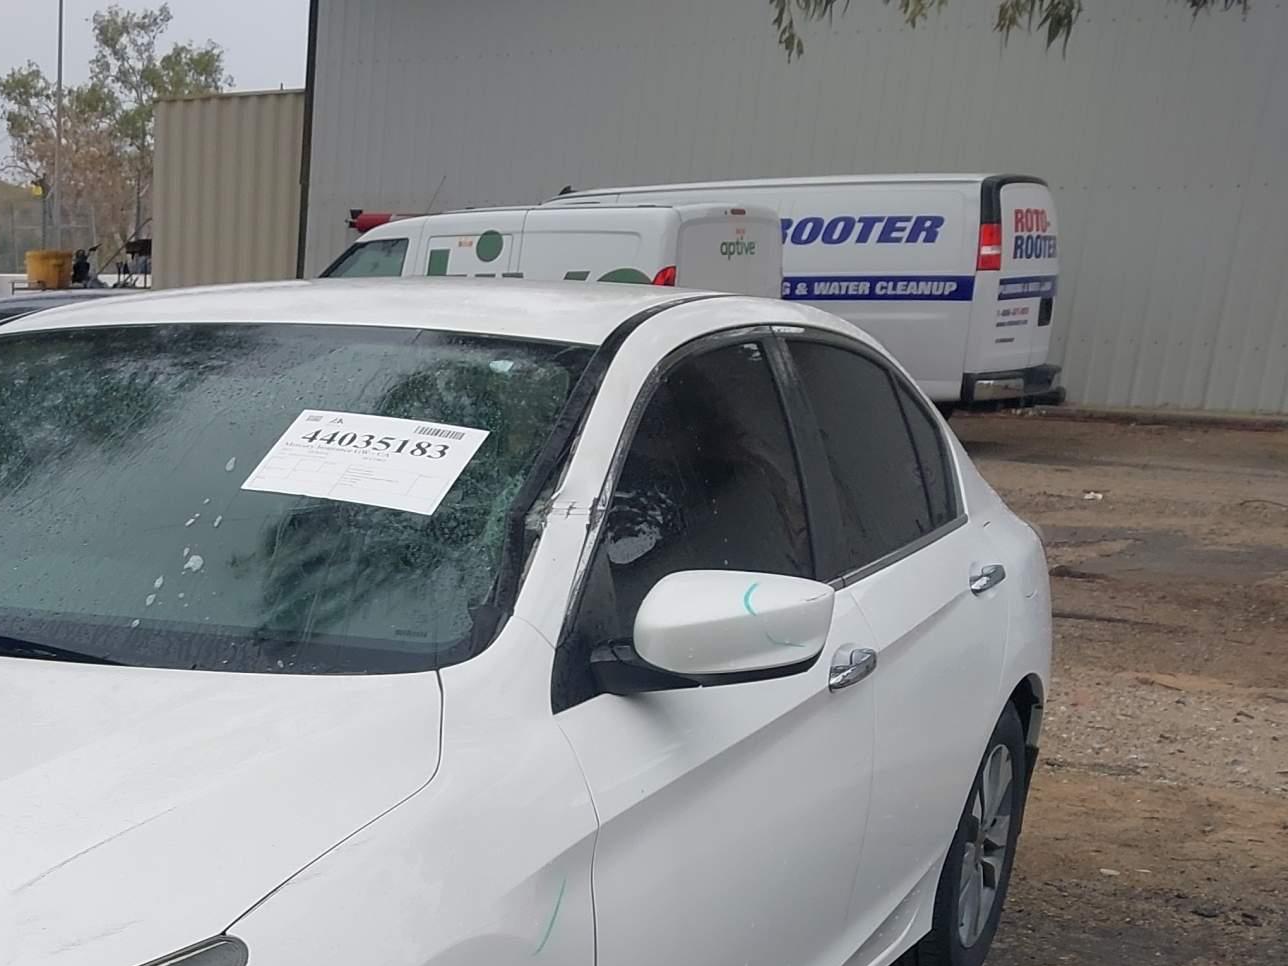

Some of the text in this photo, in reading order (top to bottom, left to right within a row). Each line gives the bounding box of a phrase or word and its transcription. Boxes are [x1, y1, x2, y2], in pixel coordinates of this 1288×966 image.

[720, 236, 756, 261] aptive
[795, 282, 808, 296] &
[814, 281, 871, 296] WATER
[875, 281, 958, 296] CLEANUP
[301, 428, 451, 460] 44035183
